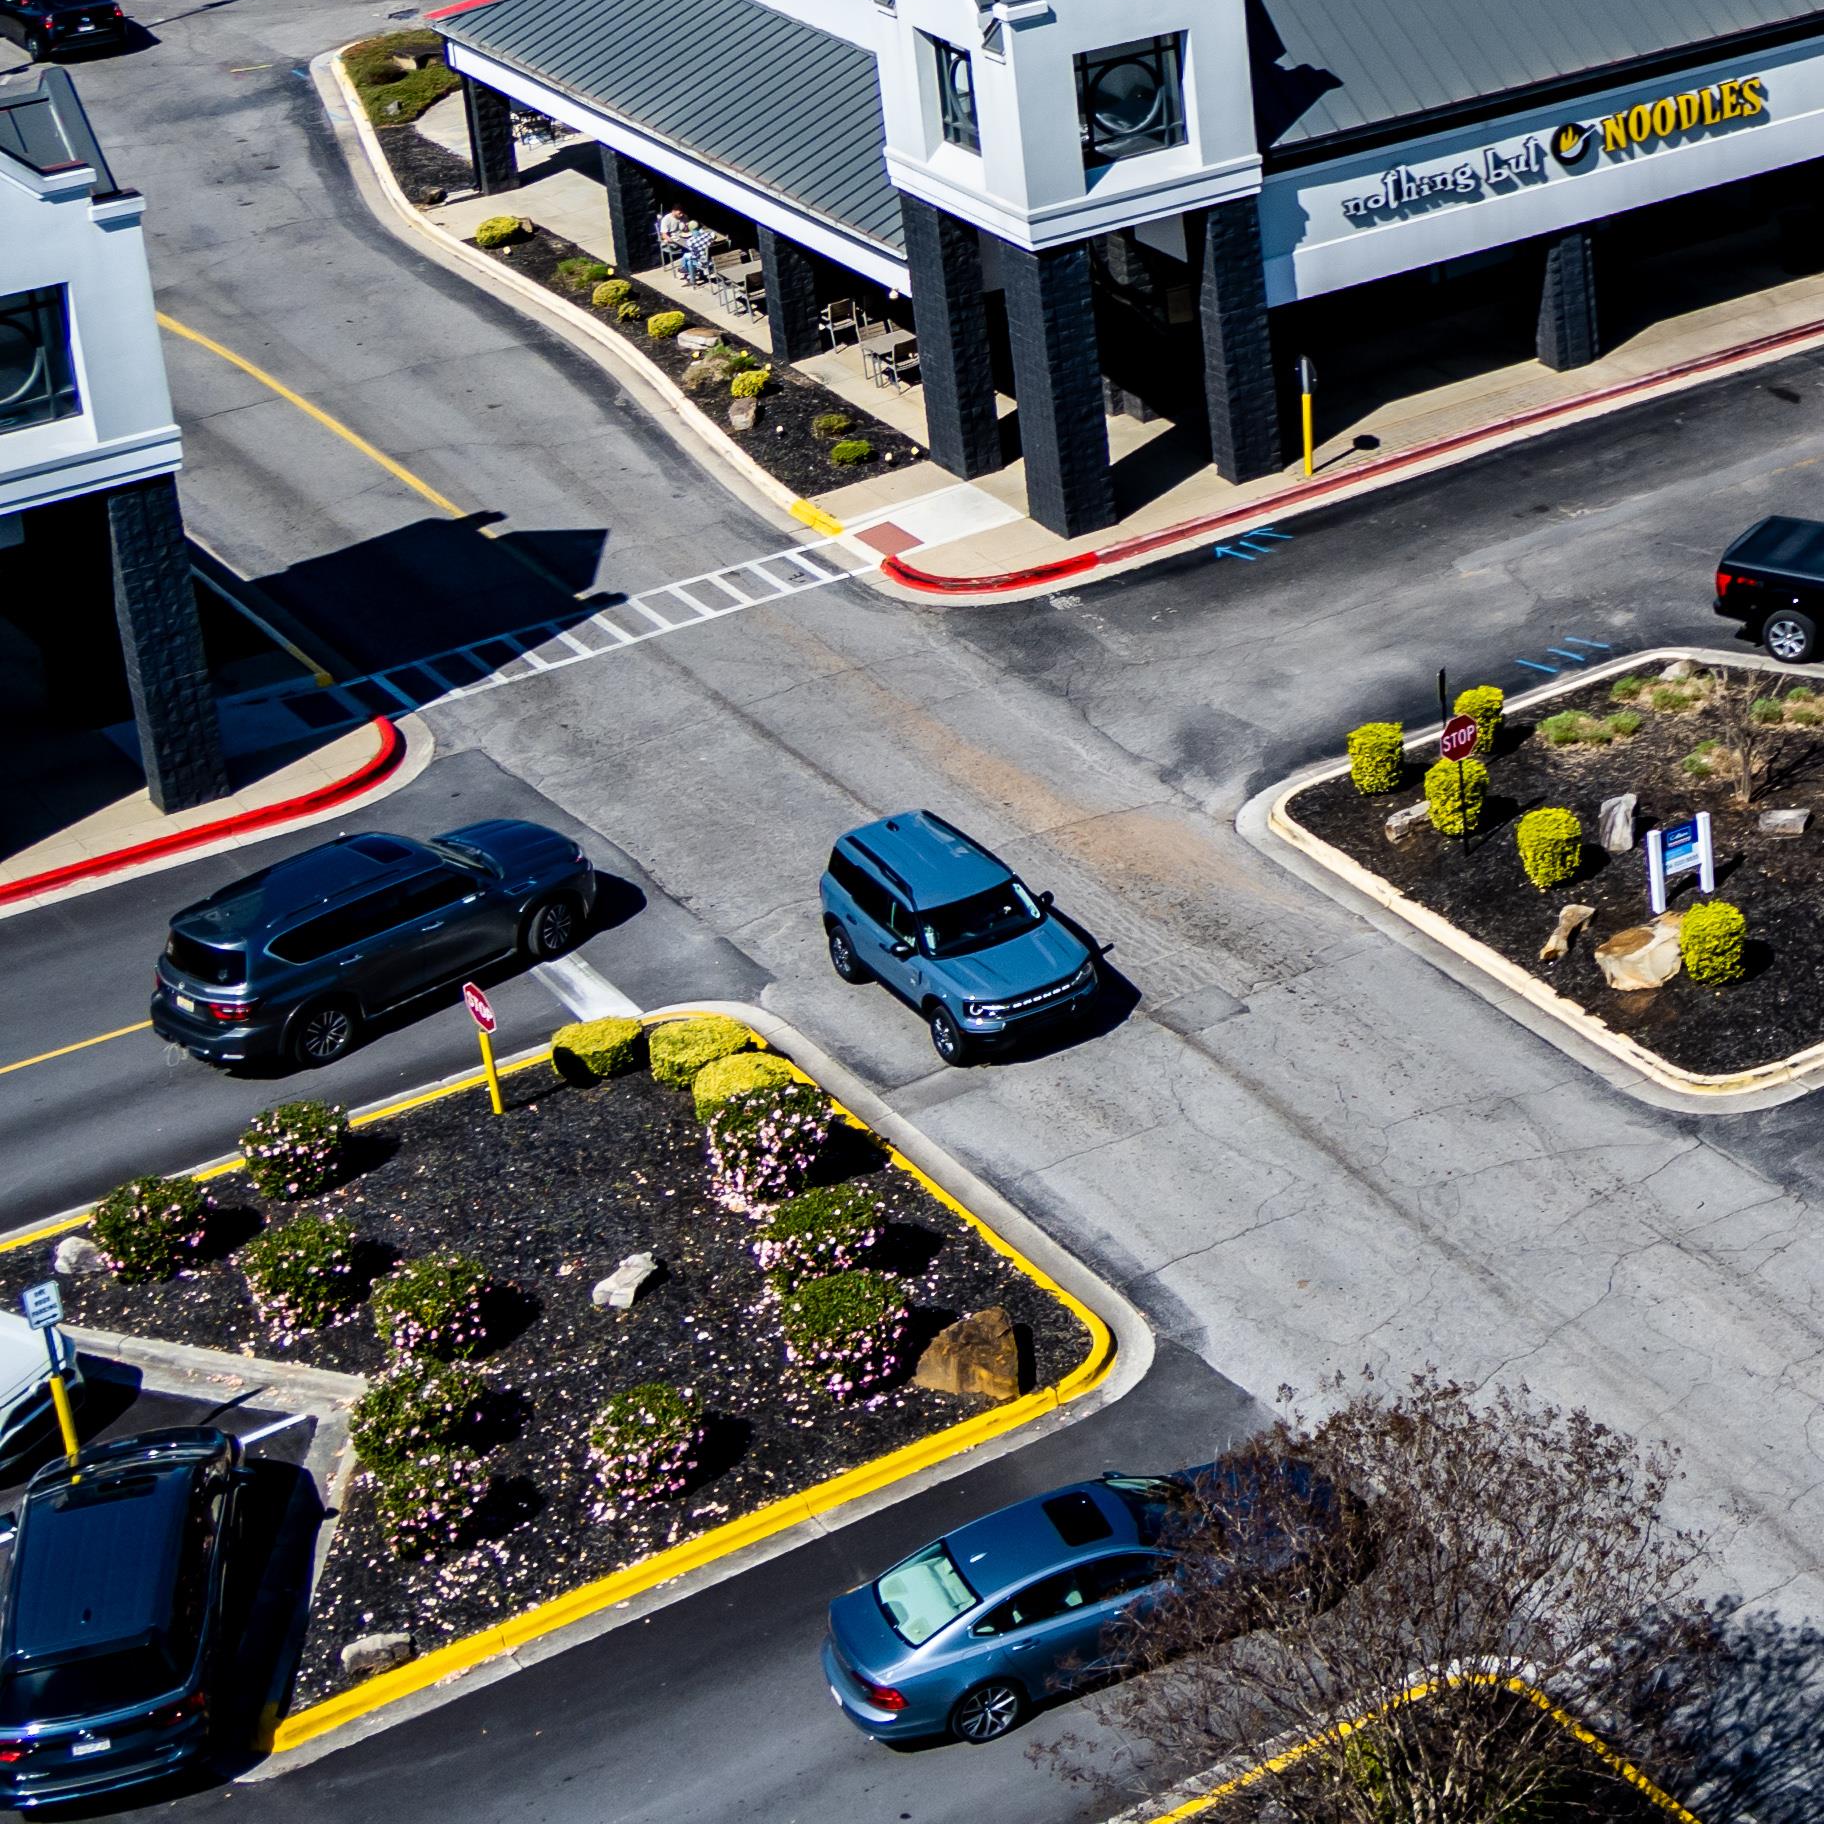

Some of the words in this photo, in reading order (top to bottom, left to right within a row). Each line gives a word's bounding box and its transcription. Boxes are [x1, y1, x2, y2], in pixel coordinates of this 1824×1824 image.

[1343, 163, 1474, 216] nothing
[1484, 136, 1541, 185] but
[1601, 77, 1764, 153] NOODLES
[1442, 724, 1476, 753] STOP
[466, 990, 494, 1022] STOP
